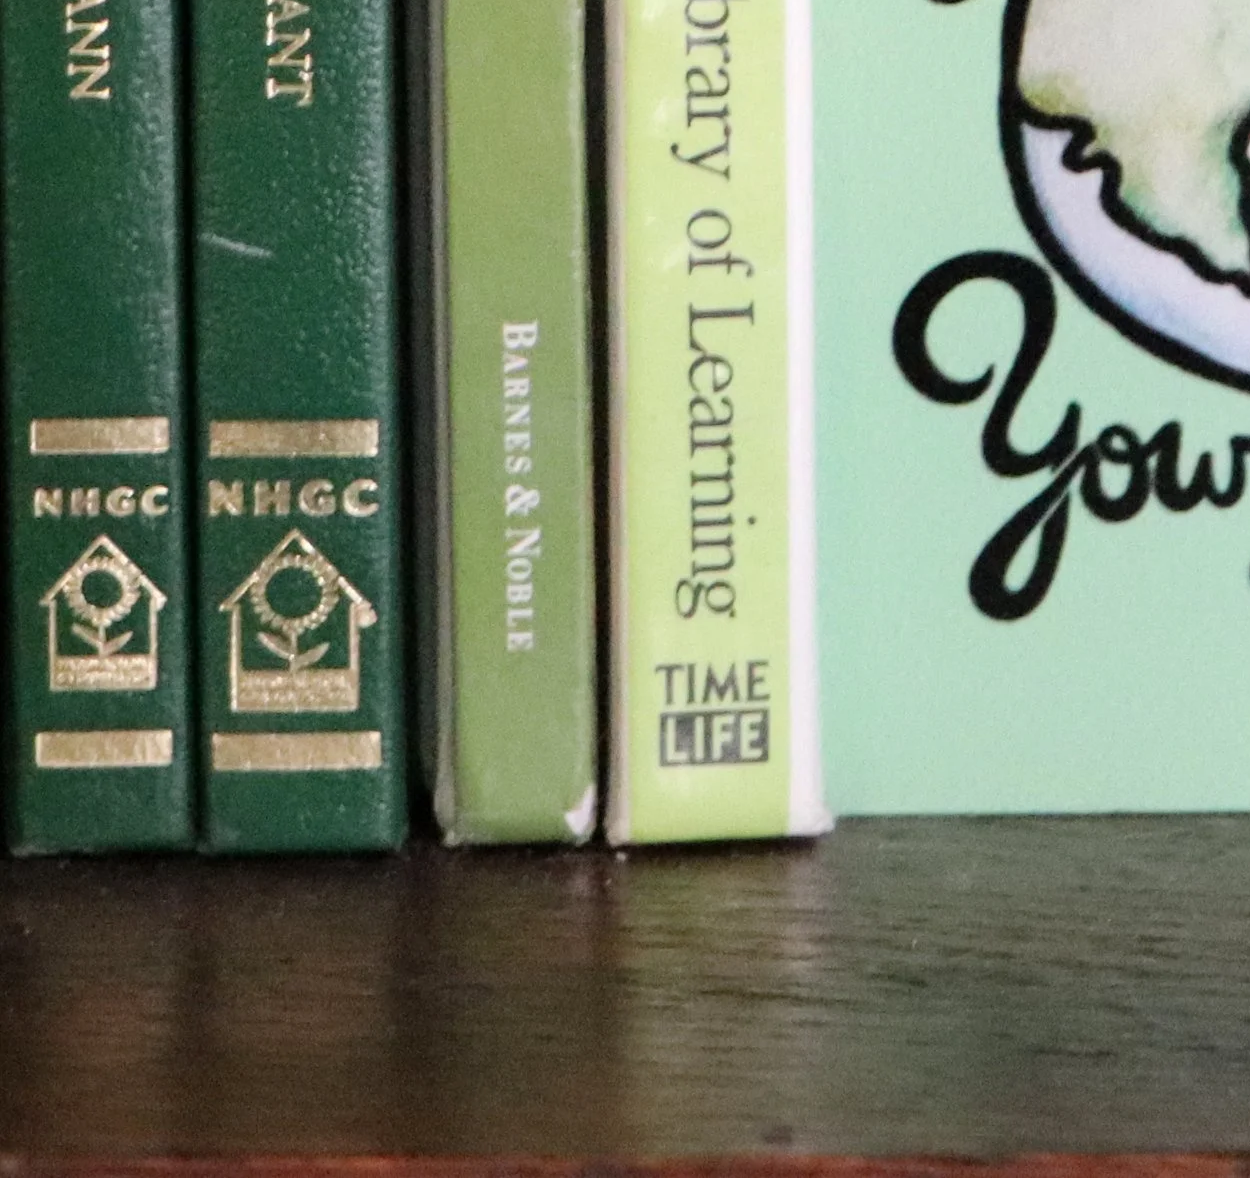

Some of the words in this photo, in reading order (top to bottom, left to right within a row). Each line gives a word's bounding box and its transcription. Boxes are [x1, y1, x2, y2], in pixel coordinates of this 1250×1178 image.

[686, 209, 755, 277] of
[502, 320, 539, 475] BARNES
[675, 301, 757, 619] Learning
[34, 486, 170, 518] NHGC
[208, 478, 380, 518] NHGC
[505, 483, 541, 516] &
[505, 526, 542, 653] NOBLE
[655, 660, 771, 706] TIME
[663, 711, 768, 762] LIFE
